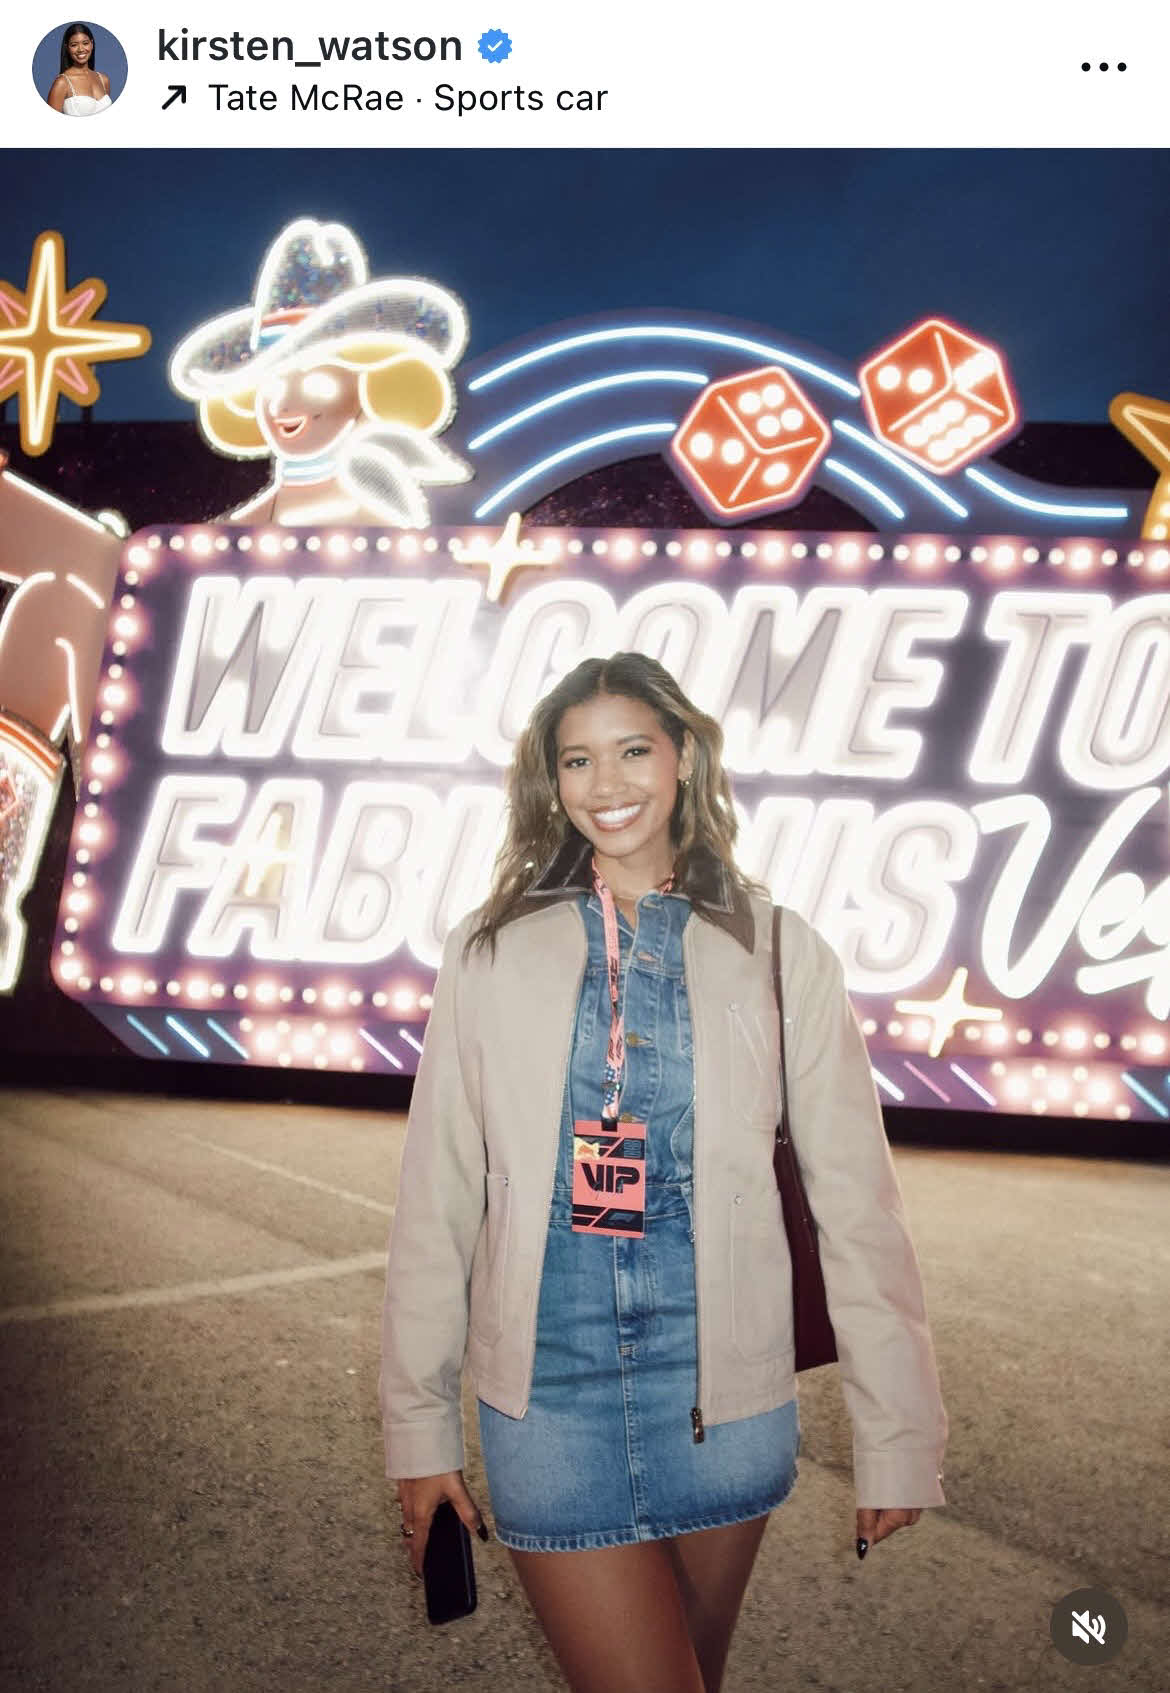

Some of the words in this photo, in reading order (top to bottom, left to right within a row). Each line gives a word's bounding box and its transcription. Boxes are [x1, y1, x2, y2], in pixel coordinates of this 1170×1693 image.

[161, 576, 969, 780] WELCOME
[969, 590, 1170, 790] TO
[111, 776, 979, 994] FABUS
[581, 1162, 641, 1194] VIP
